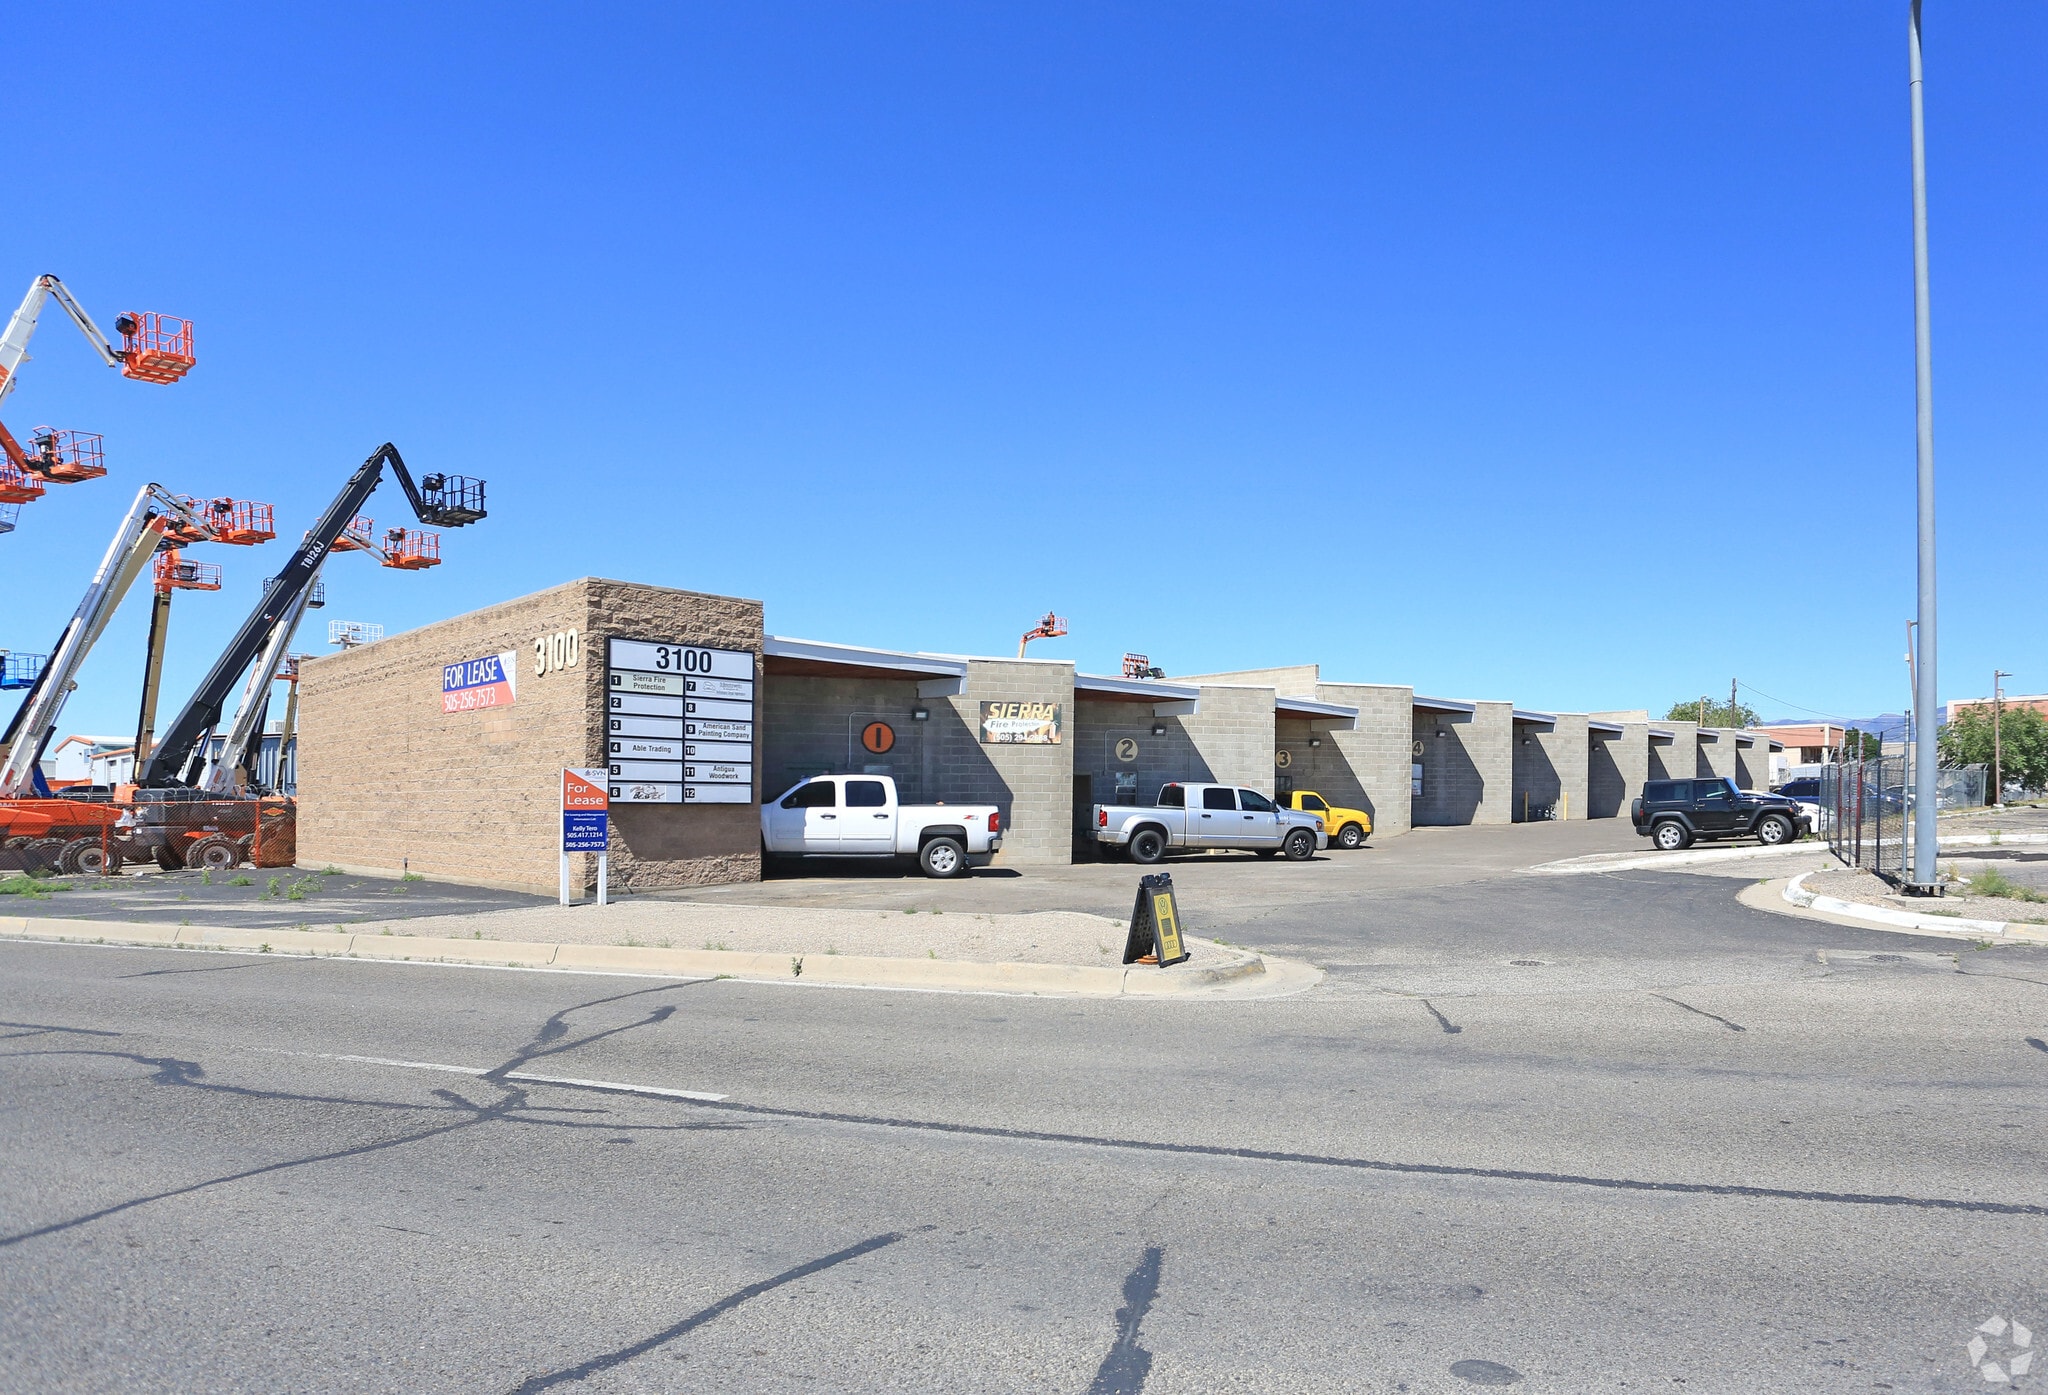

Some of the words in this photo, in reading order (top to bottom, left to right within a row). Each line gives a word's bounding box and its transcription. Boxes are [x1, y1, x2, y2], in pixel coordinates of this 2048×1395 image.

[301, 541, 325, 569] TB126J
[534, 628, 579, 676] 3100
[656, 646, 712, 673] 3100
[444, 665, 464, 690] FOR
[467, 657, 498, 685] LEASE
[633, 674, 652, 682] Sierra
[633, 682, 666, 691] Protection
[688, 682, 694, 690] 7
[444, 686, 496, 711] 505-256-7573
[613, 698, 619, 707] 2
[987, 703, 1054, 720] SIERRA
[613, 721, 619, 729] 3
[703, 722, 730, 730] American
[990, 720, 1009, 728] Fire
[688, 725, 694, 733] 9
[698, 730, 722, 738] Painting
[723, 731, 750, 739] Company
[993, 733, 1012, 743] (505)
[613, 743, 618, 751] 4
[632, 744, 647, 752] Able
[648, 745, 672, 754] Trading
[686, 746, 695, 754] 10
[1120, 739, 1134, 759] 2
[1412, 741, 1422, 755] 4
[1278, 751, 1289, 767] 3
[612, 766, 618, 774] 5
[686, 768, 694, 776] 11
[713, 765, 735, 773] Antigua
[567, 783, 589, 793] For
[612, 788, 618, 796] 6
[686, 789, 695, 797] 12
[567, 794, 604, 805] Lease
